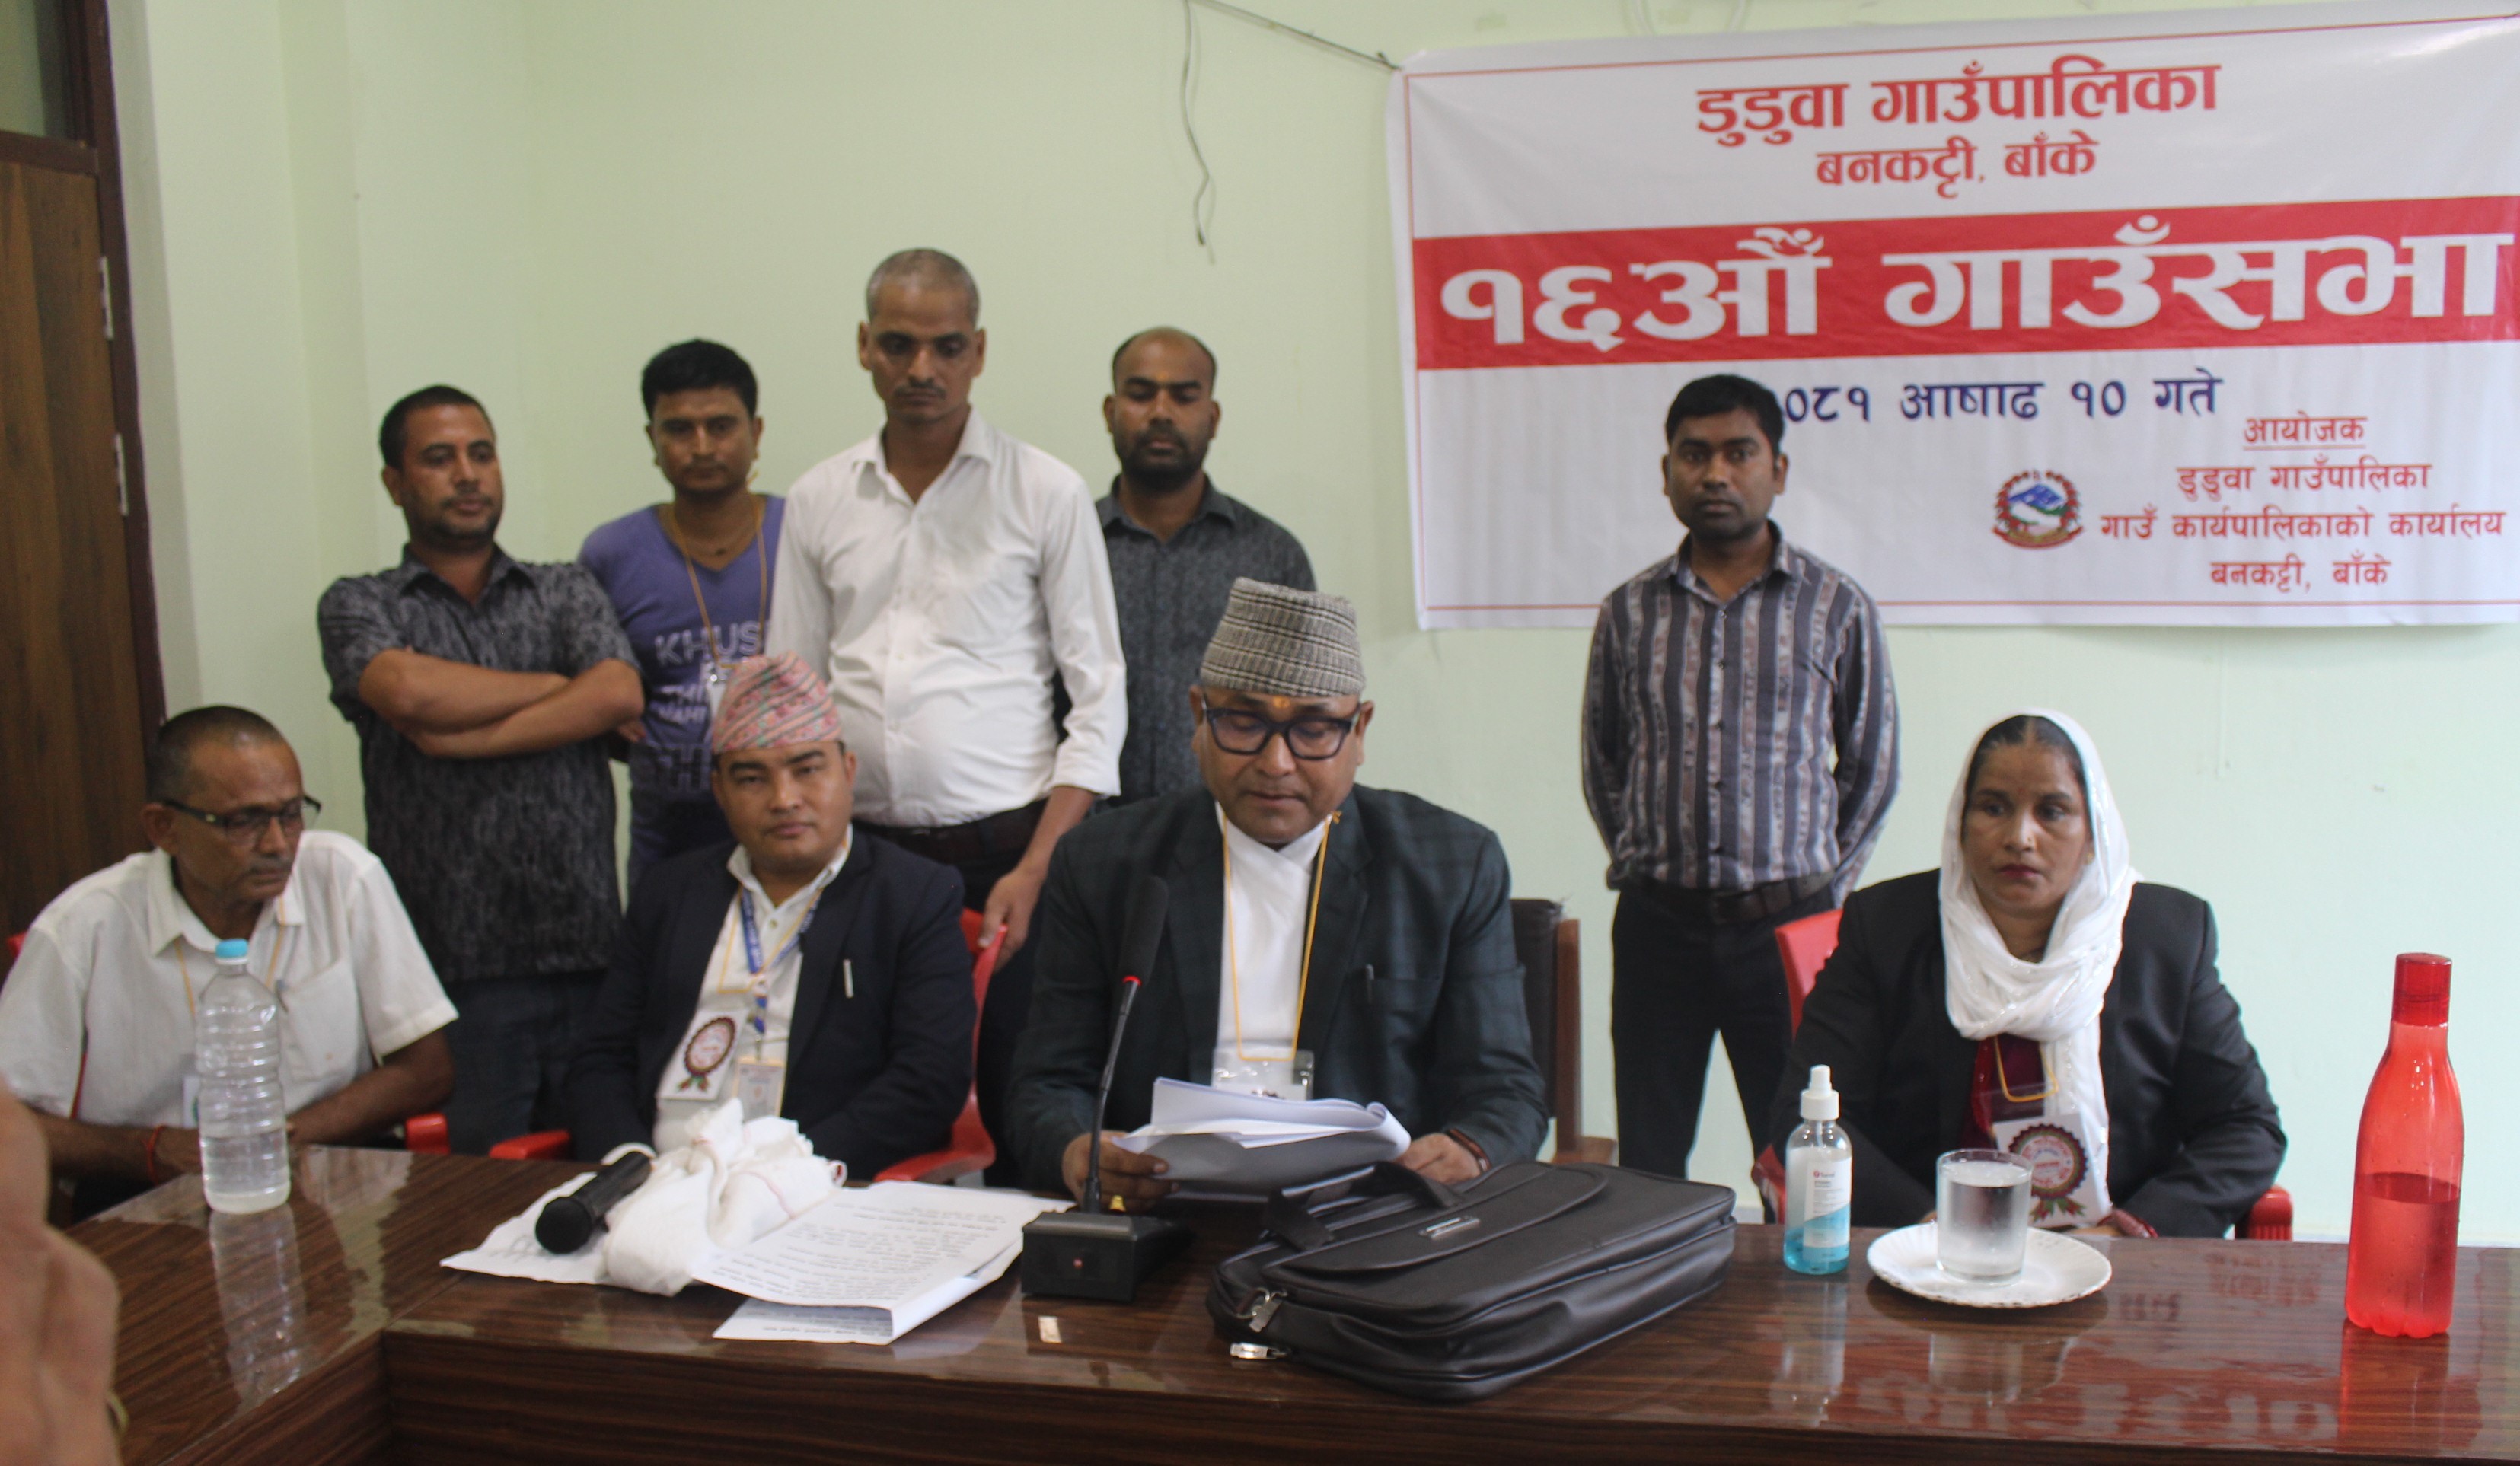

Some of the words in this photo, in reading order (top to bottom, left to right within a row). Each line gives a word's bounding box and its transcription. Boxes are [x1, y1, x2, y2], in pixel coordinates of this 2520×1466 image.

[1695, 83, 1850, 148] डुडुवा
[1871, 53, 2222, 125] गाउँपालिका
[2003, 129, 2099, 178] बाँके
[1880, 215, 2515, 331] गाउँसभा
[1782, 385, 1871, 423] ०८१
[1901, 382, 2046, 421] आषाढ
[2070, 380, 2127, 419] १०
[2152, 367, 2224, 416] गते
[2243, 410, 2368, 445] आयोजक
[2175, 466, 2256, 502] डुडुवा
[2270, 454, 2433, 492] गाउँपालिका
[2100, 502, 2159, 541] गाउँ
[2171, 503, 2375, 539] कार्यपालिकाको
[2388, 502, 2506, 539] कार्यालय
[2331, 548, 2392, 586] बाँके
